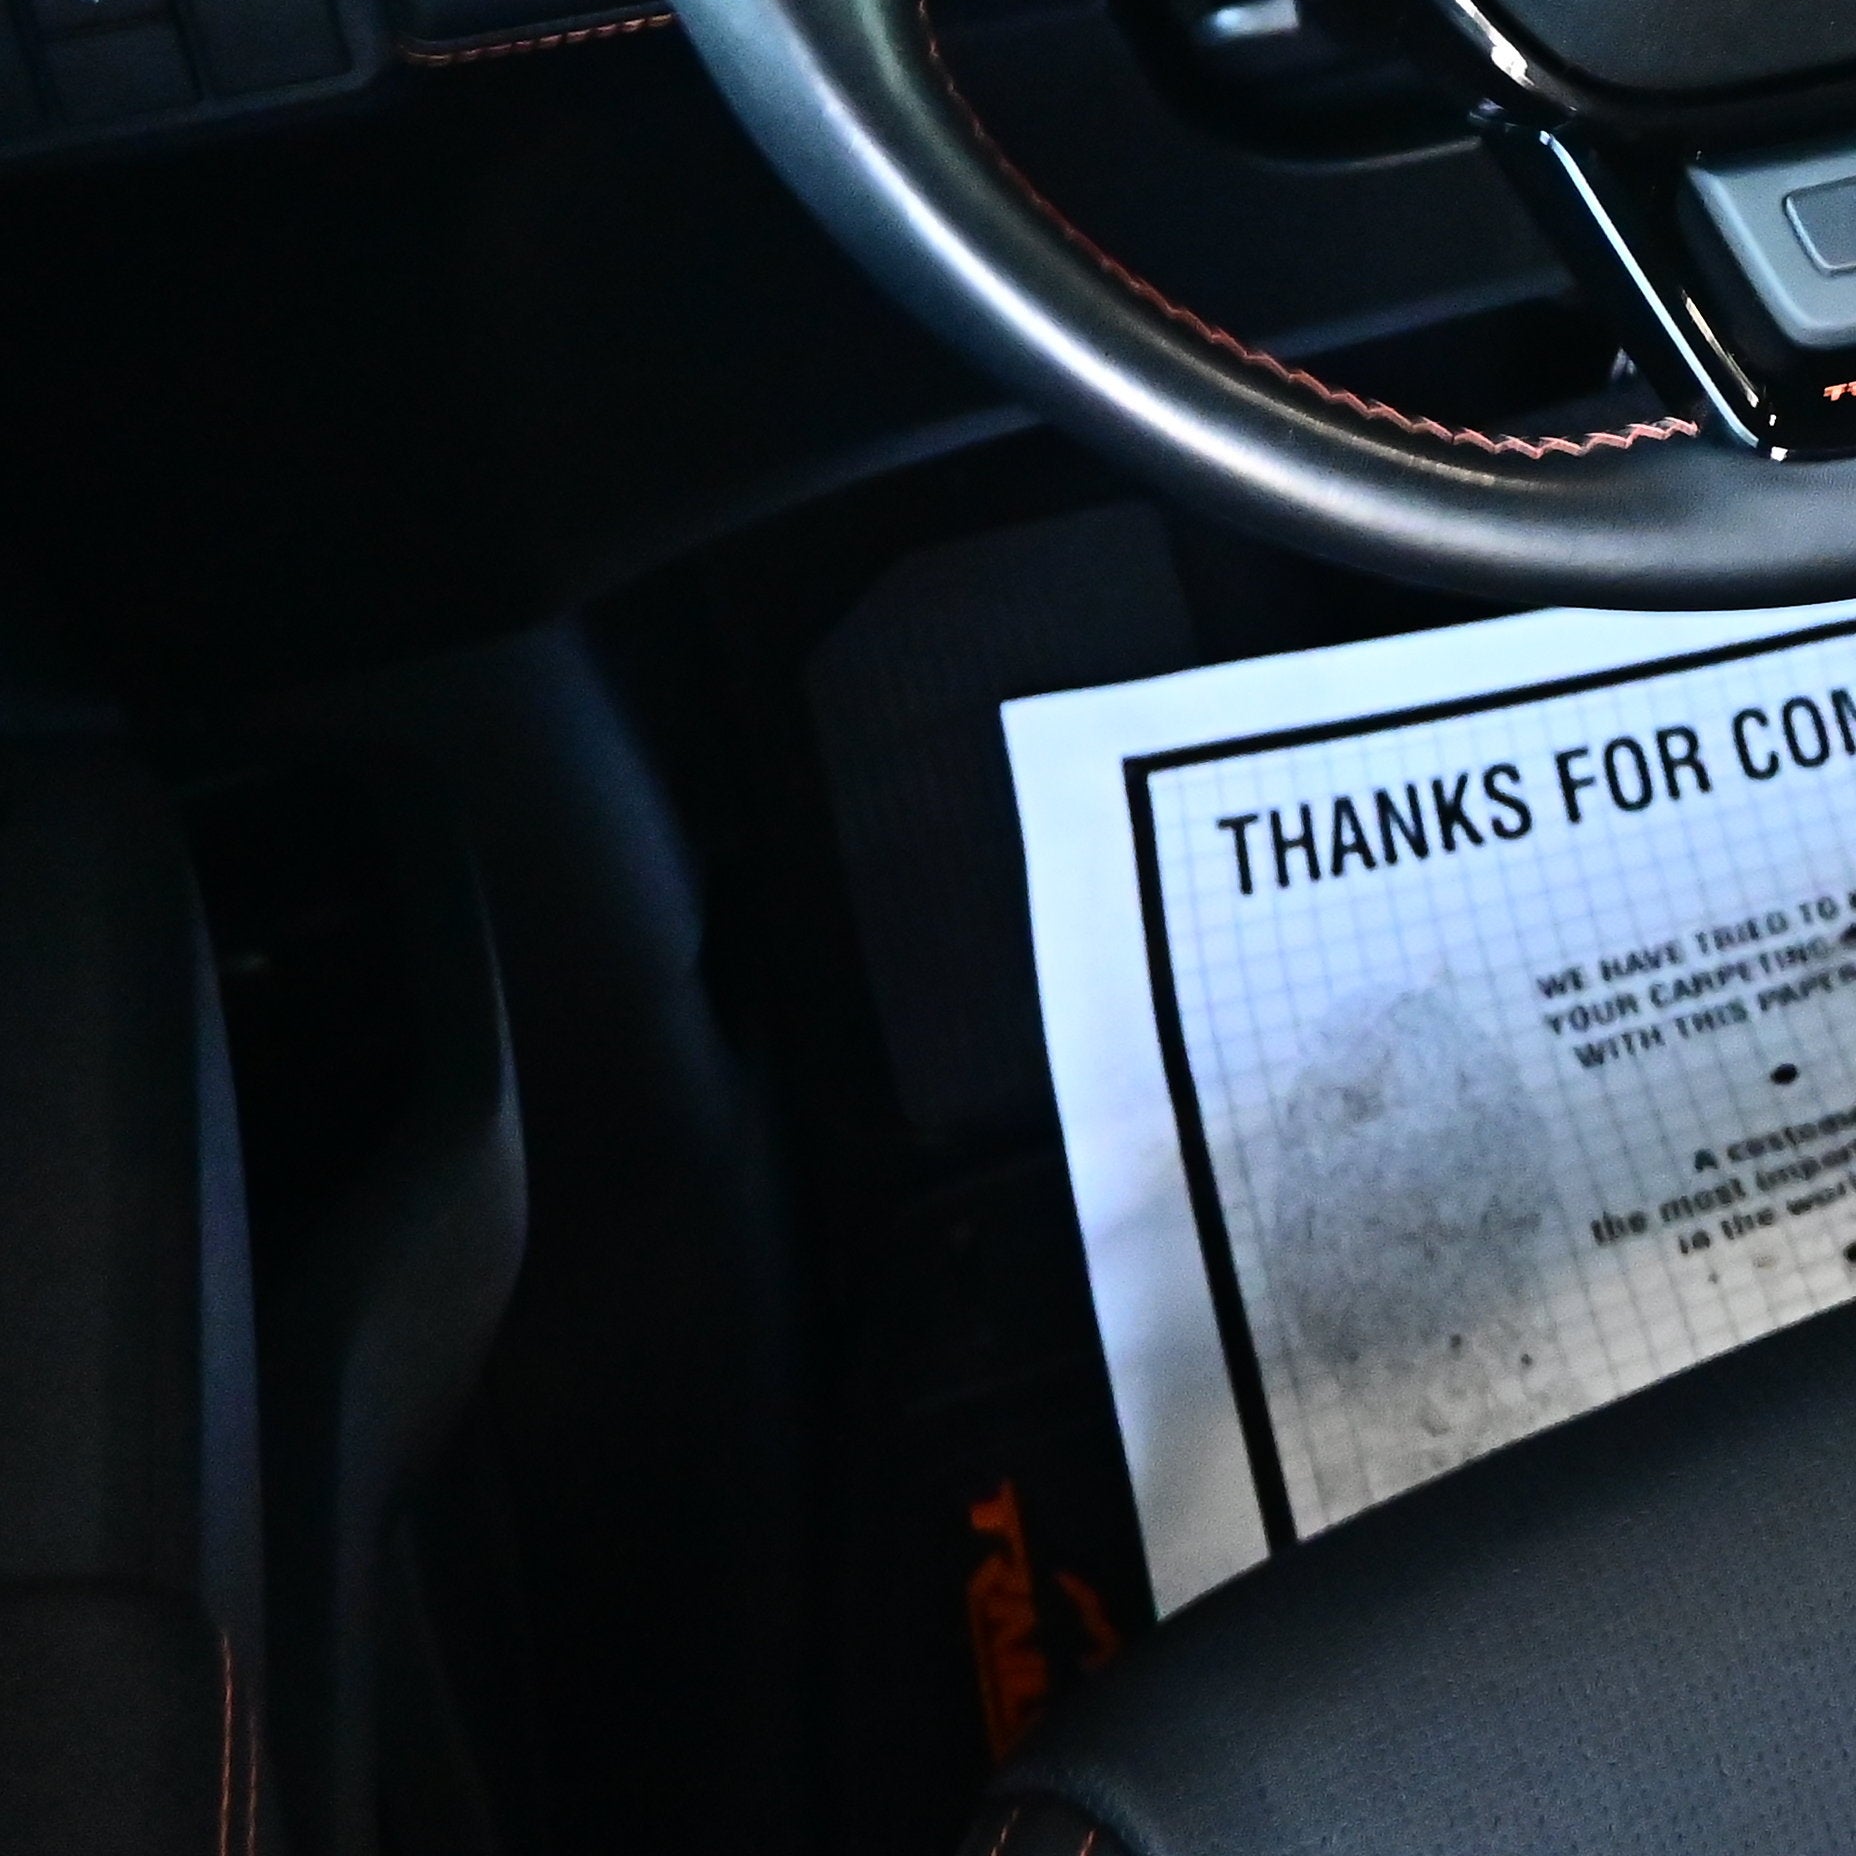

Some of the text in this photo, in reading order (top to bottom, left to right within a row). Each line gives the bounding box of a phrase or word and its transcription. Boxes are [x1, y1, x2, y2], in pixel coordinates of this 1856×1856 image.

[1216, 761, 1534, 896] THANKS
[1554, 723, 1712, 824] FOR
[1536, 965, 1585, 999] WE
[1600, 946, 1684, 982] HAVE
[1695, 913, 1790, 955] TRIED
[1801, 896, 1840, 926] TO
[1545, 992, 1640, 1035] YOUR
[1649, 939, 1833, 1008] CARPETING
[1573, 1027, 1666, 1069] WITH
[1676, 999, 1749, 1039] THIS
[1694, 1147, 1719, 1172] A
[1590, 1209, 1648, 1245] the
[1659, 1176, 1747, 1222] most
[1720, 1205, 1776, 1241] the
